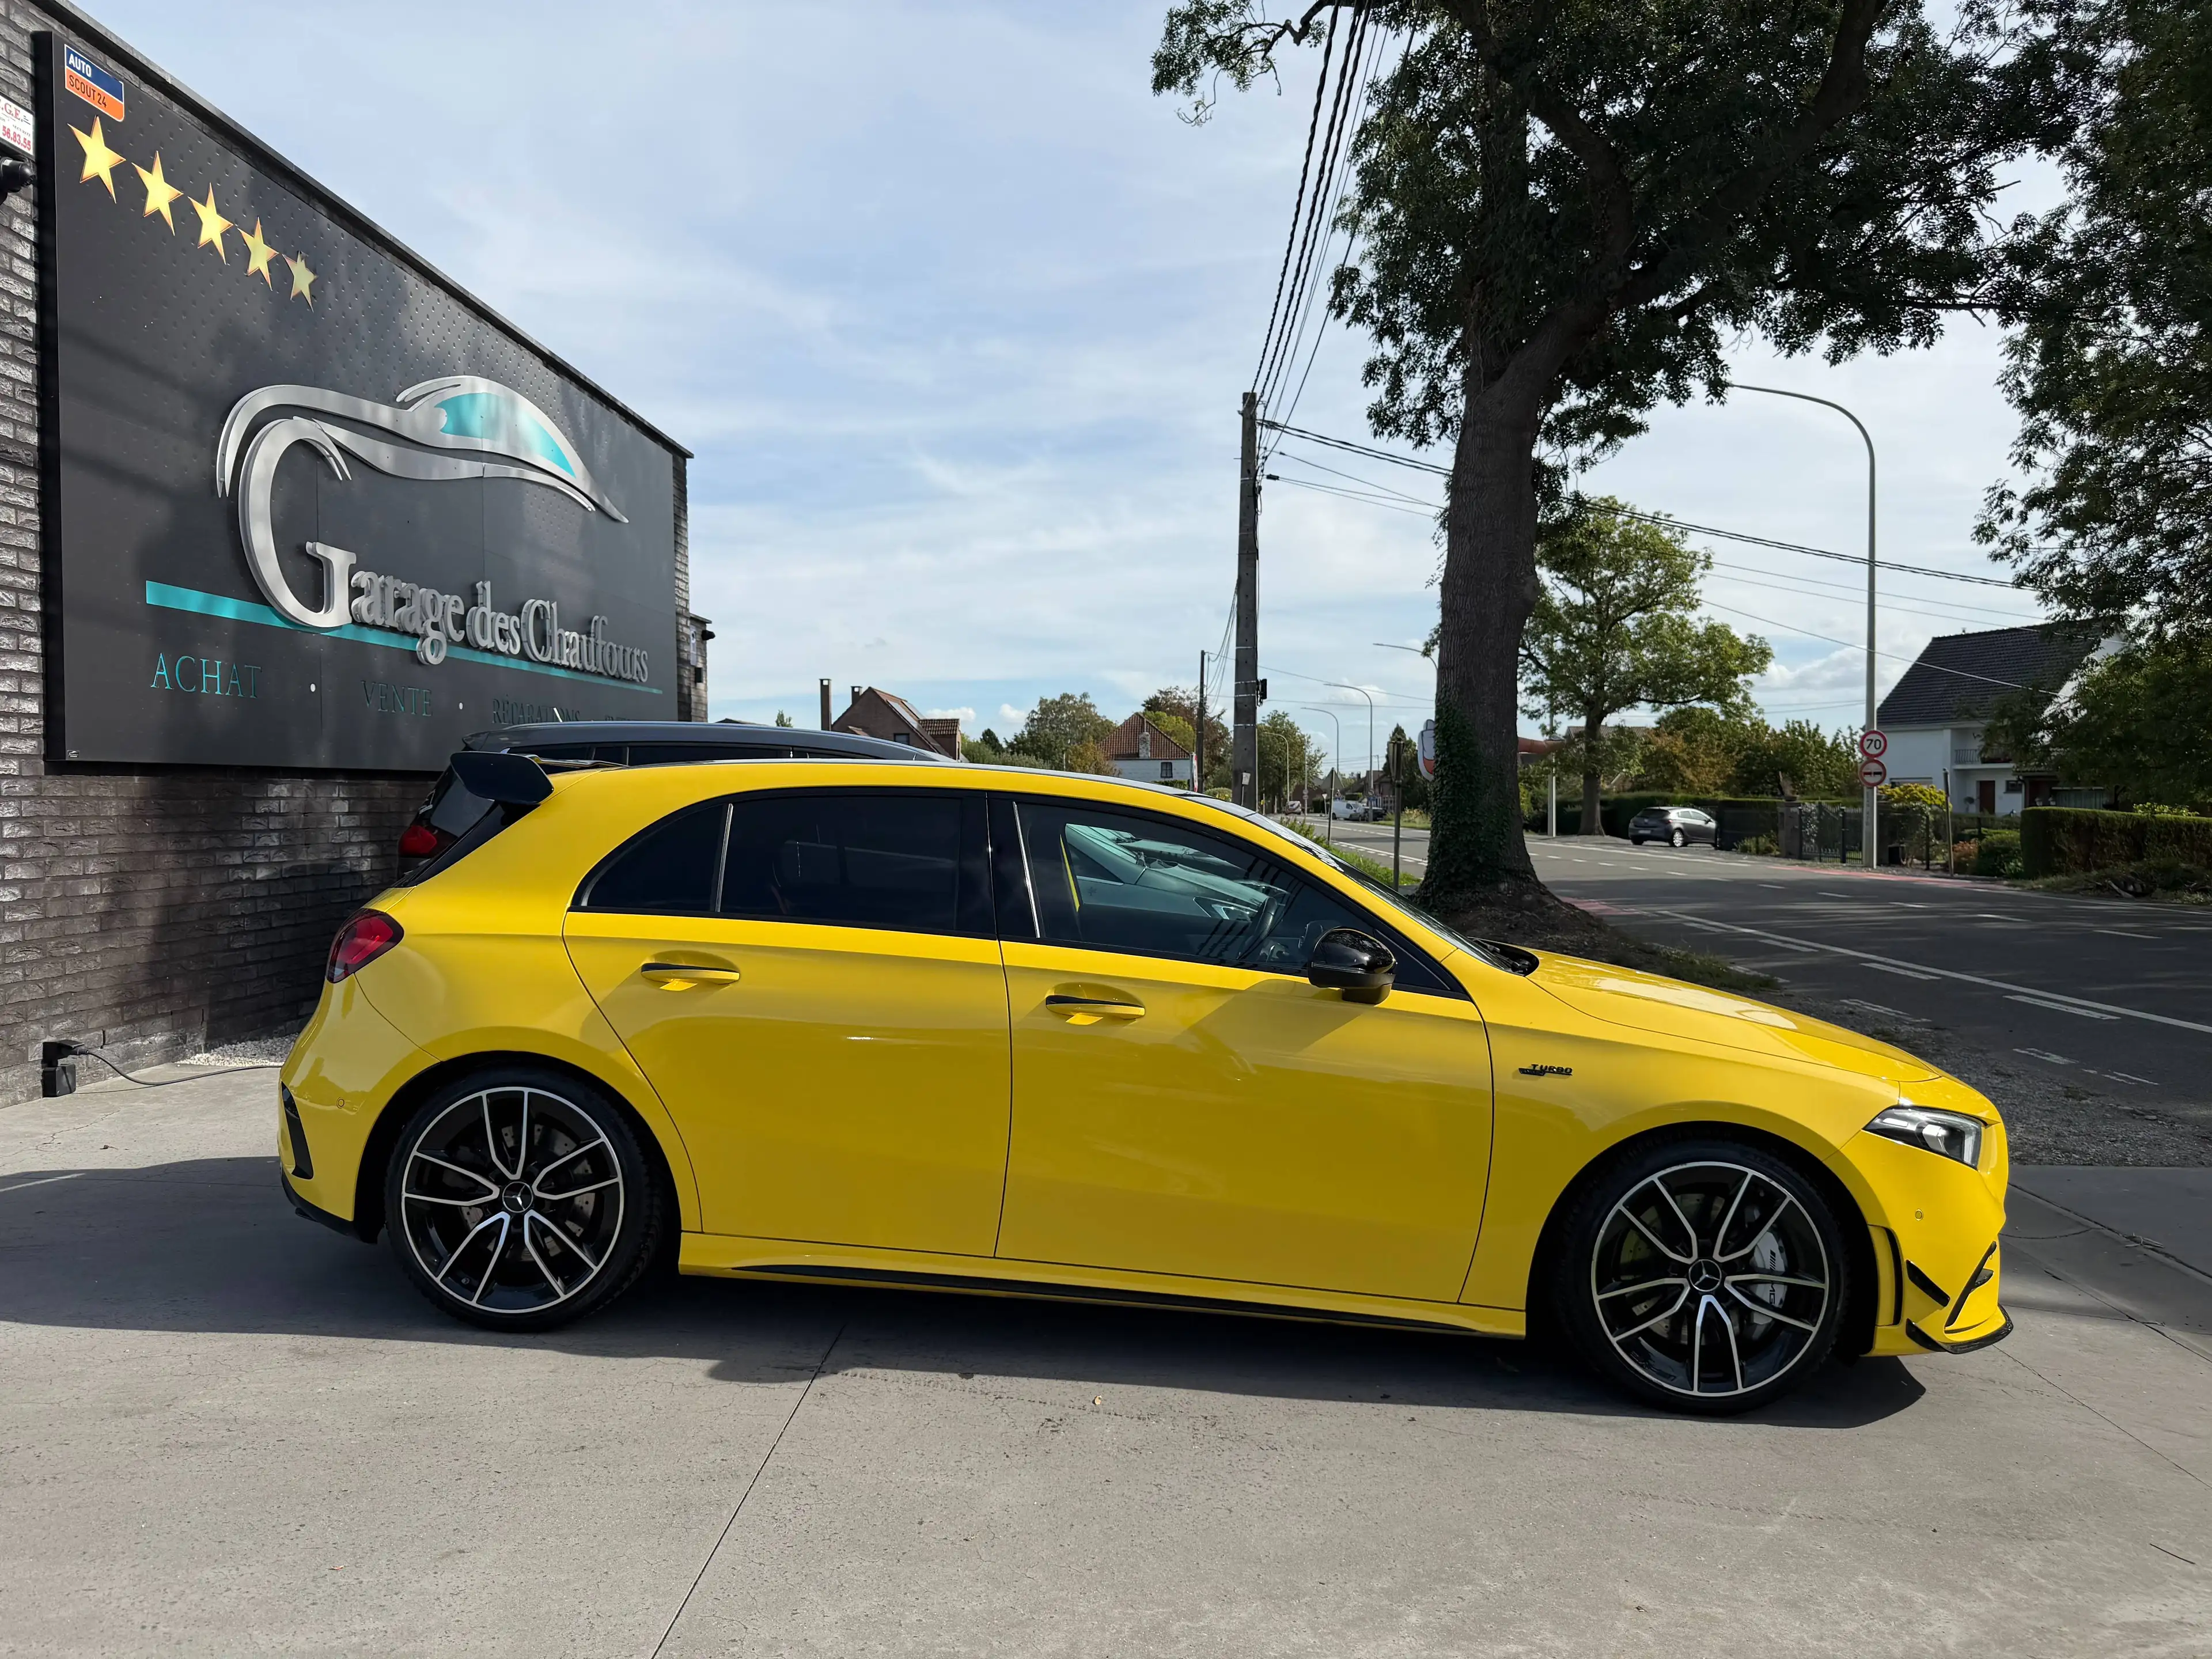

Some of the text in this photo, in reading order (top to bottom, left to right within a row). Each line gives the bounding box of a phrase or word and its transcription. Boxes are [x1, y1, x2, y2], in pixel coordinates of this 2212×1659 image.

[69, 53, 92, 78] AUTO
[238, 418, 465, 665] Garage
[465, 580, 521, 654] des
[150, 652, 262, 699] ACHAT
[361, 680, 433, 717] VENTE
[1866, 738, 1881, 749] 70
[1531, 1064, 1573, 1073] TURBO
